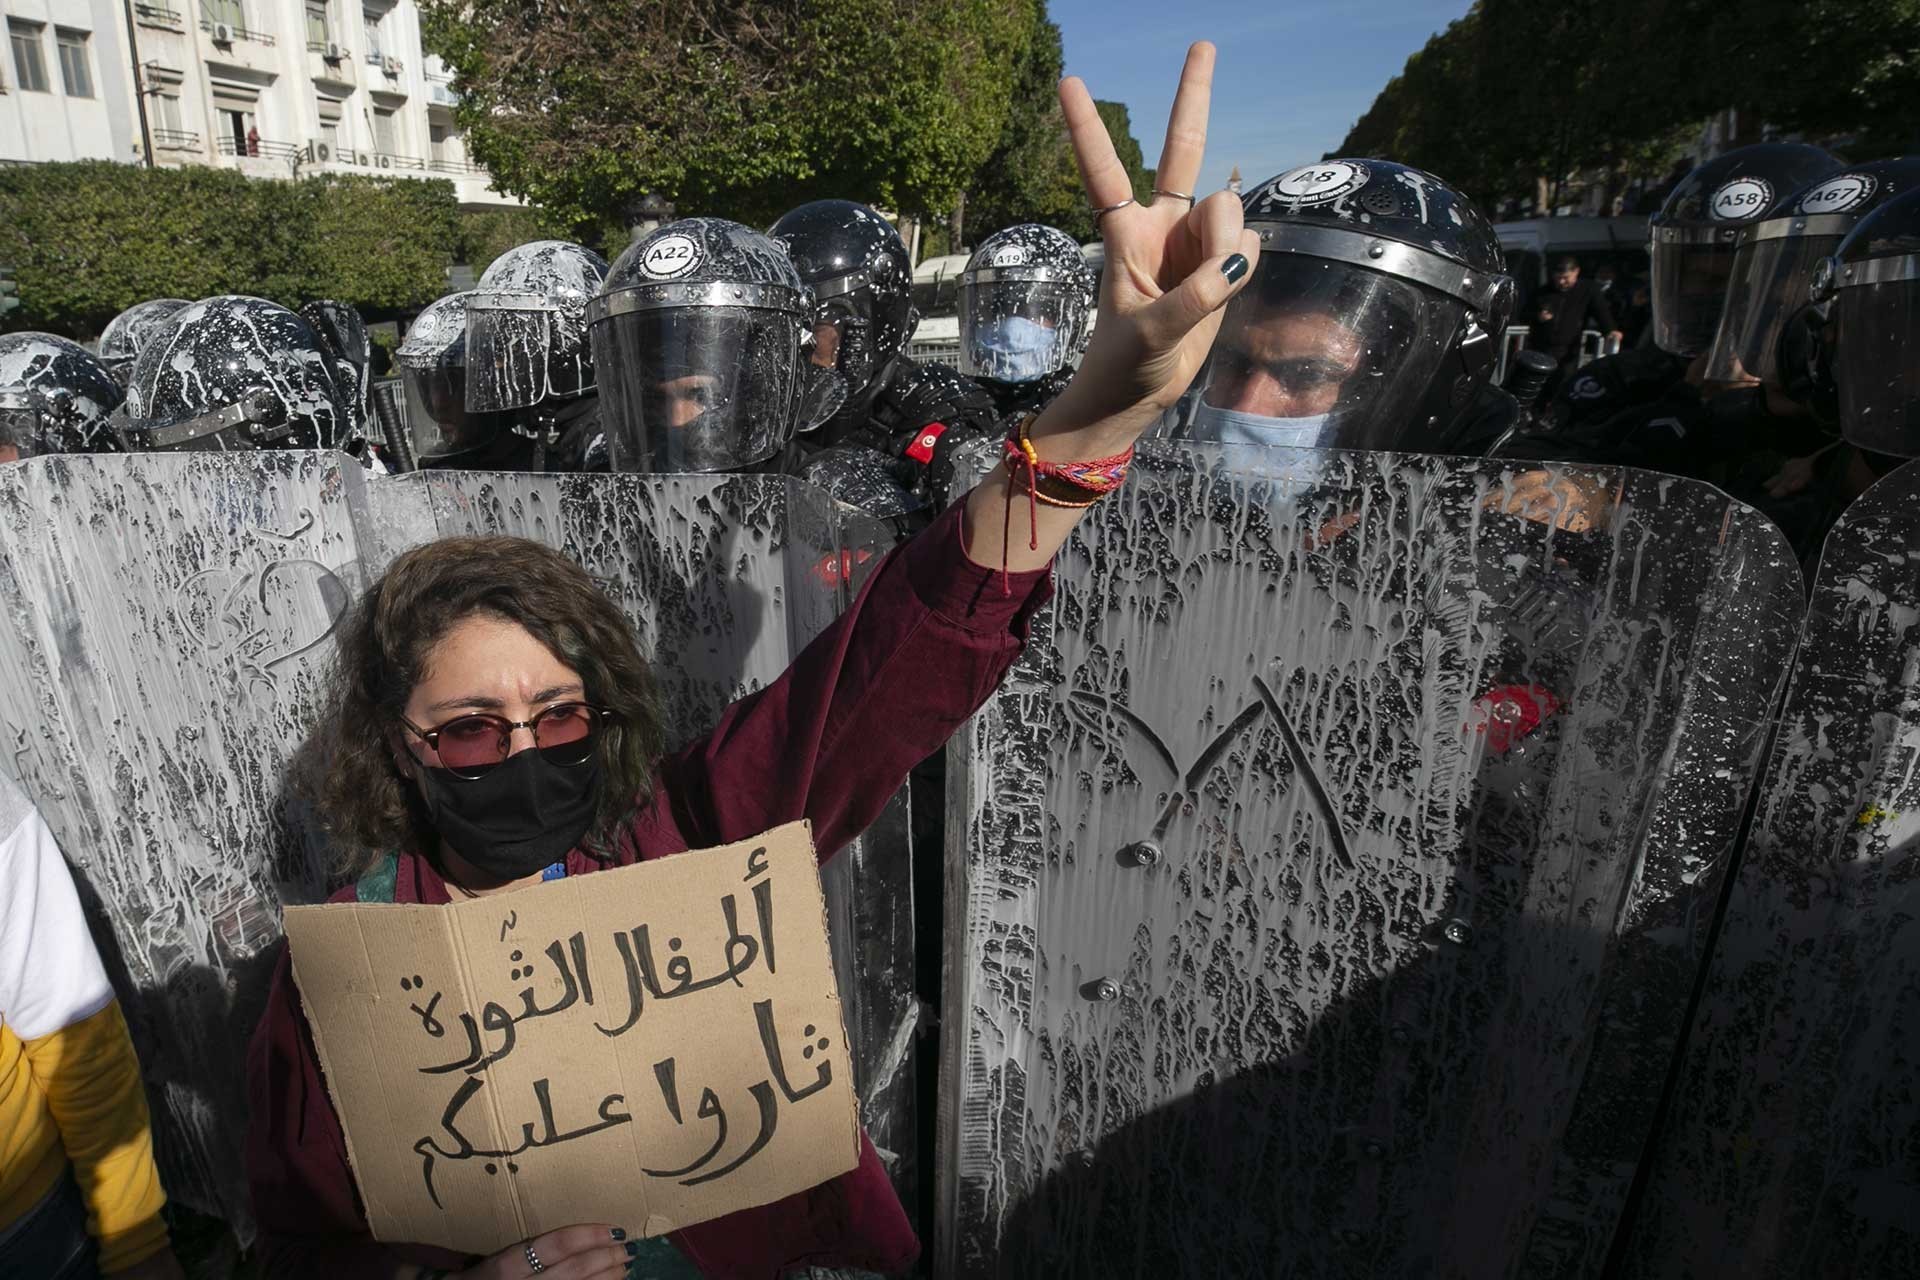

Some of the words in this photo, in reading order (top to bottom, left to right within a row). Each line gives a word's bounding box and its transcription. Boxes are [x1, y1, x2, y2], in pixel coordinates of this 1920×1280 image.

[1291, 170, 1337, 183] A8
[1717, 192, 1759, 208] A58
[1805, 187, 1858, 205] A67
[649, 245, 689, 263] A22
[995, 254, 1020, 265] A19
[594, 846, 776, 1038] أطفال
[641, 998, 833, 1187] ثاروا
[413, 1075, 633, 1210] عليكم
